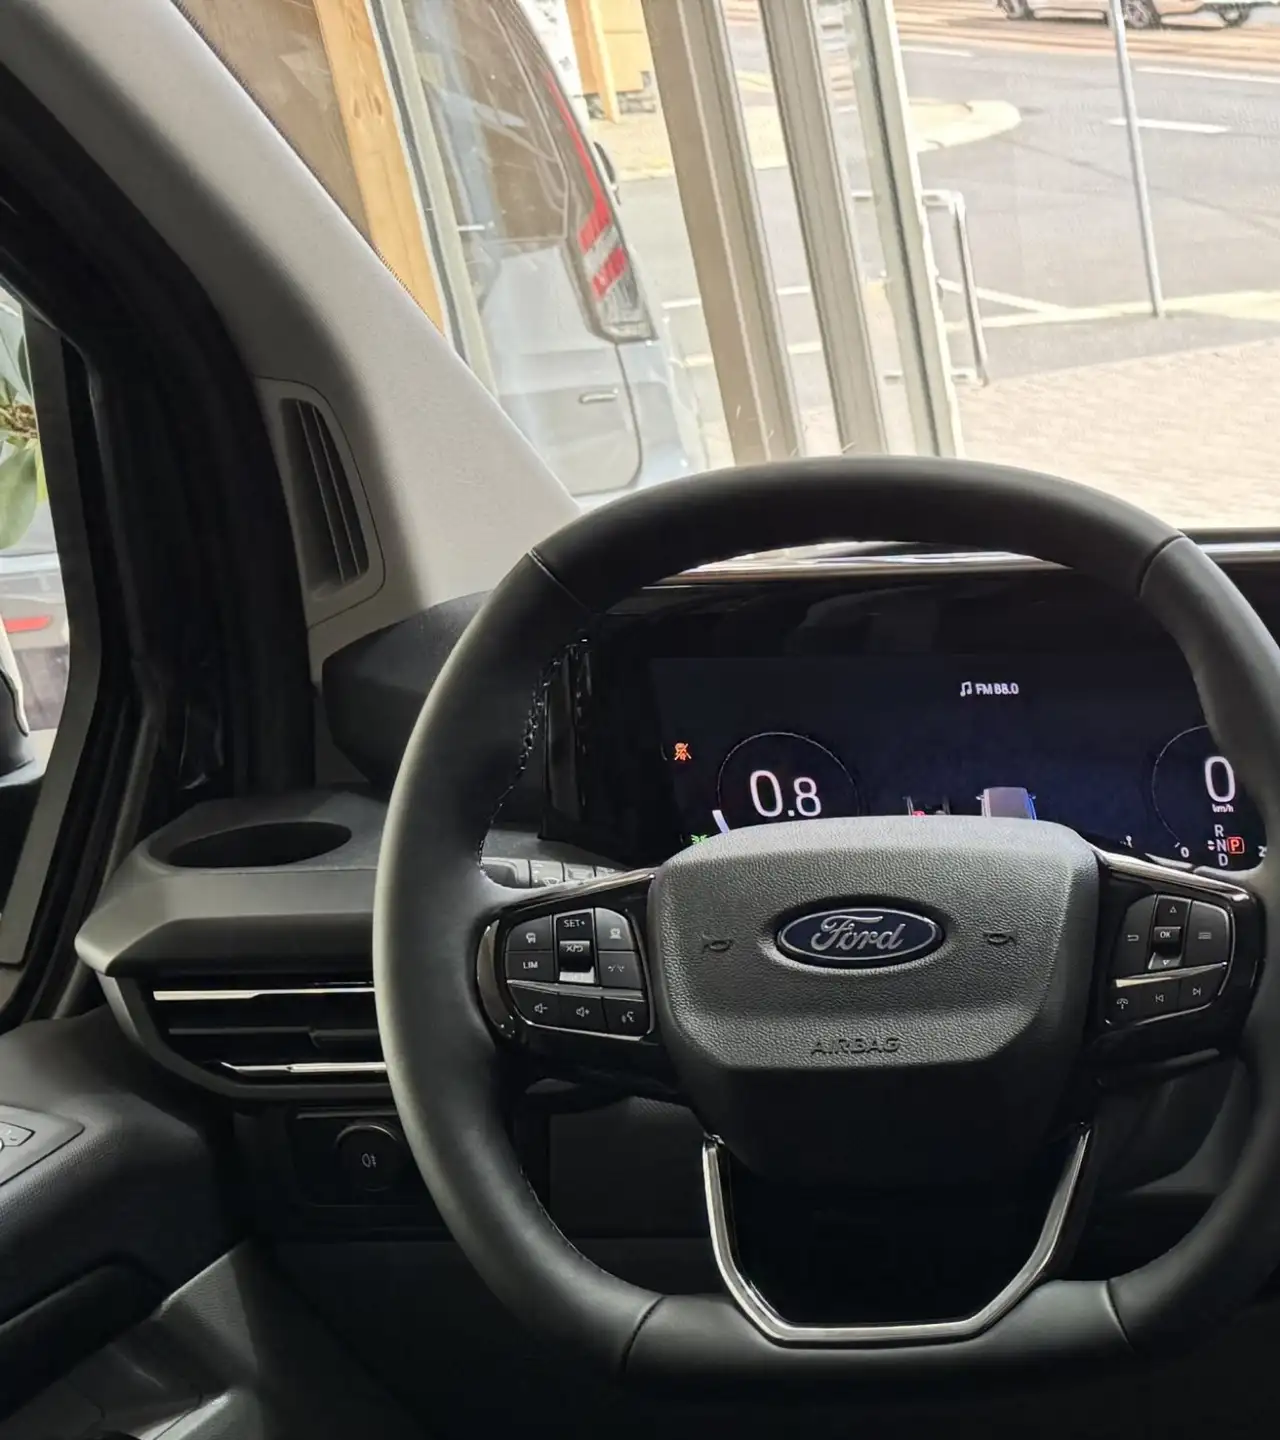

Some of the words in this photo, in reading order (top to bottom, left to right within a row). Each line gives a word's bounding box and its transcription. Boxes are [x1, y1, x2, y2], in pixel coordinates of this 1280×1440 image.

[975, 682, 993, 695] FM
[993, 682, 1020, 695] 88.0
[1204, 755, 1236, 803] 0
[749, 769, 822, 818] 0.8
[1211, 803, 1234, 813] km/h
[1214, 824, 1225, 838] R
[1216, 838, 1227, 851] N
[1230, 839, 1240, 851] P
[1218, 853, 1229, 867] D
[810, 914, 907, 951] Ford
[1159, 931, 1171, 939] OK
[522, 960, 539, 969] LIM
[811, 1036, 900, 1056] AIRBAG
